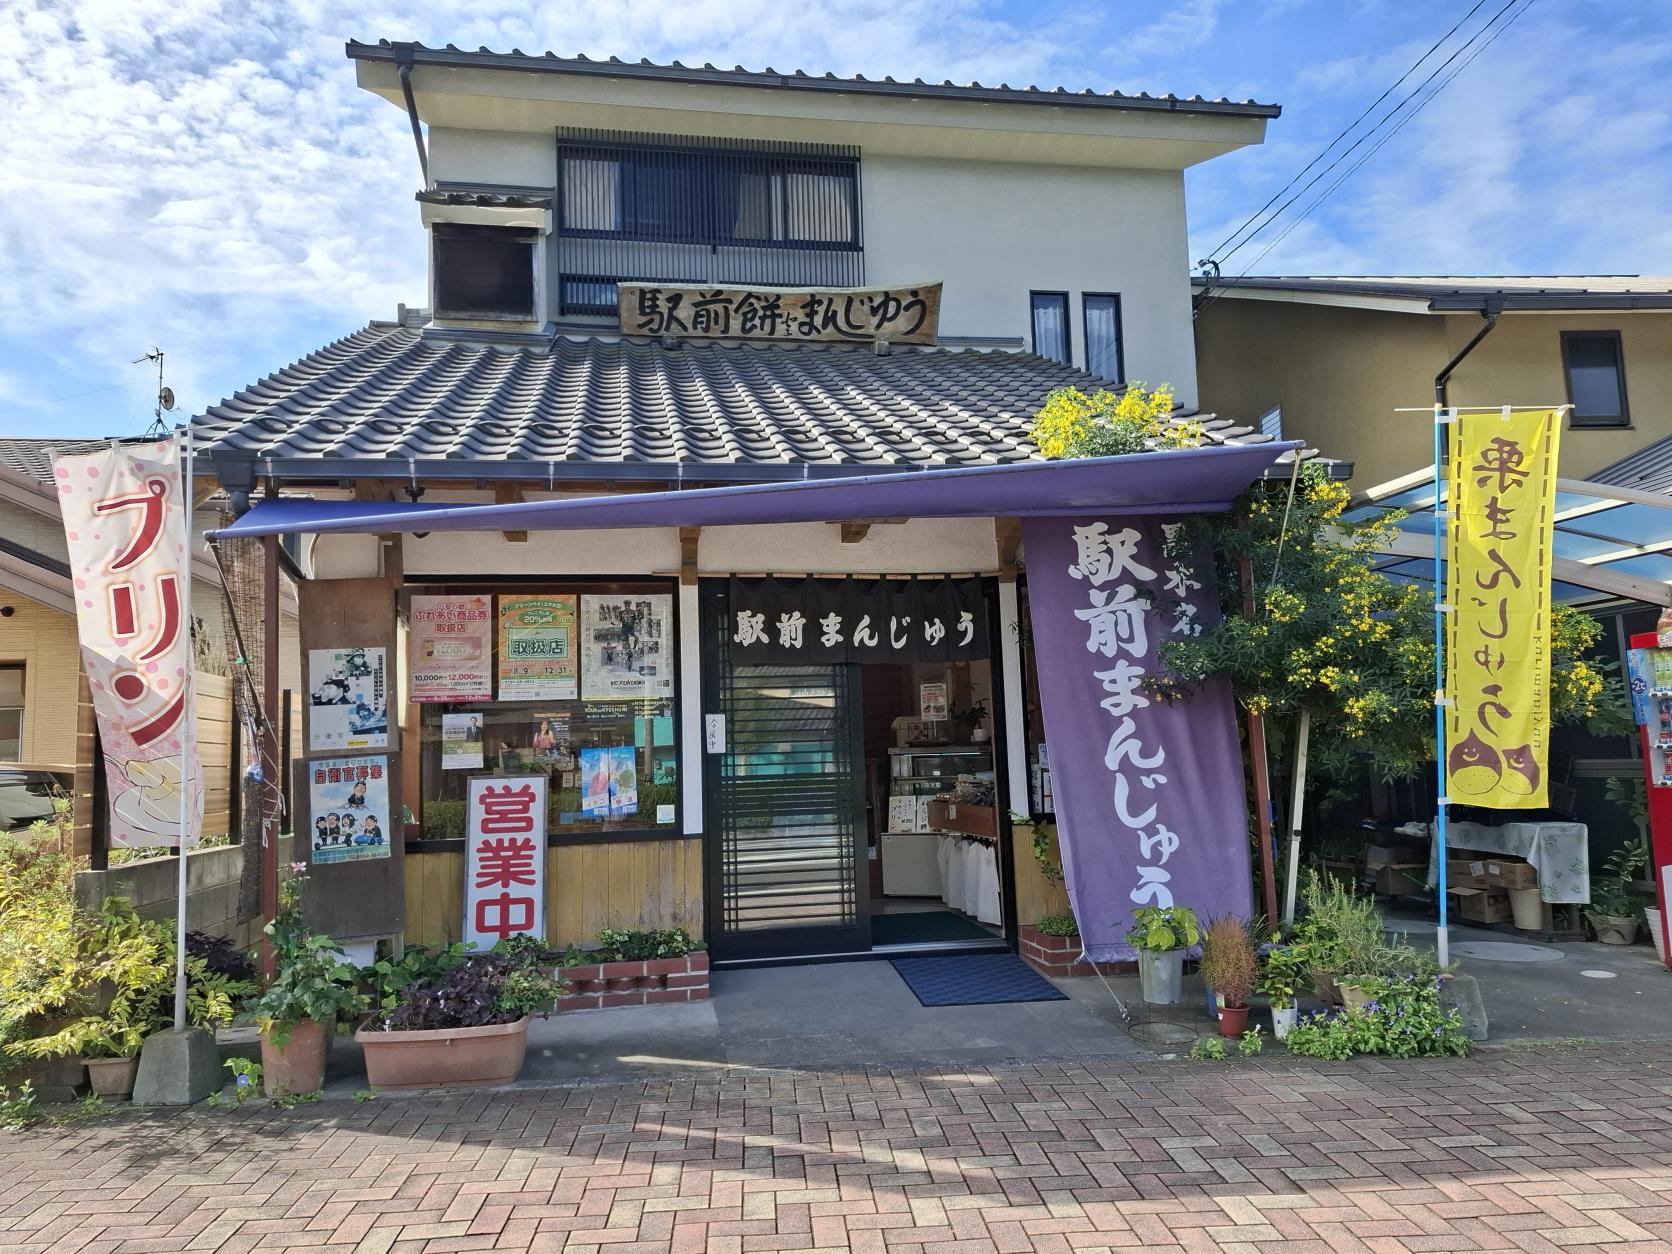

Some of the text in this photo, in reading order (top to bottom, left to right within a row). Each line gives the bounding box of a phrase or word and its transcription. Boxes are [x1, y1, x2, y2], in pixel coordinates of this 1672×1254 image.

[96, 477, 185, 748] プリン
[436, 623, 466, 633] 取扱店
[733, 609, 975, 649] 駅前まんじゅう
[511, 638, 566, 656] 取扱店
[1067, 521, 1180, 910] 駅前まんじゅう
[315, 765, 383, 785] 自衛官募集
[475, 784, 536, 940] 営業中
